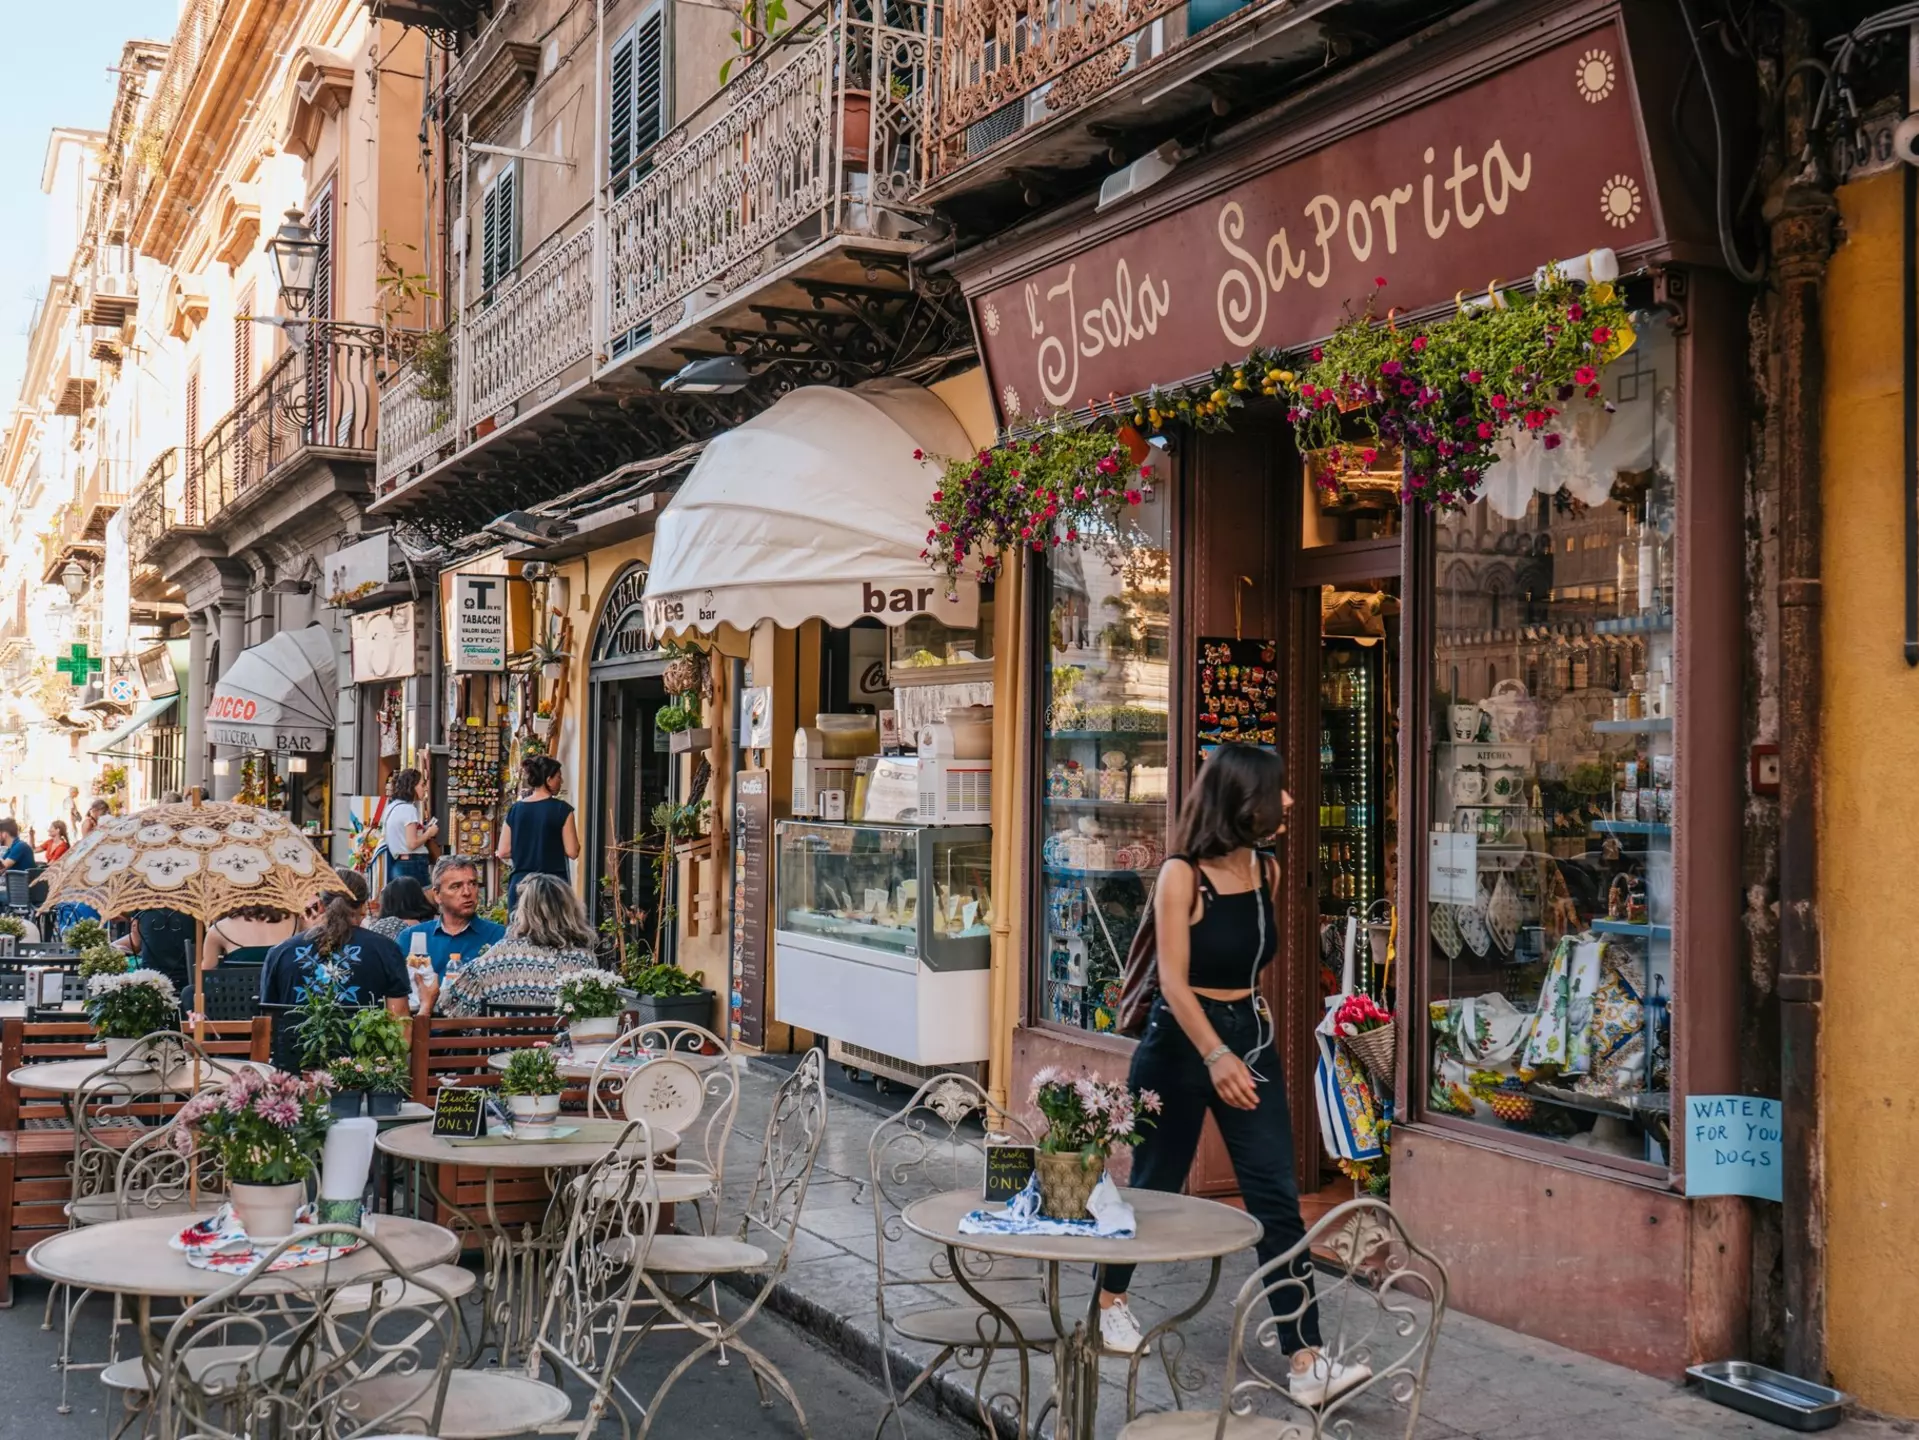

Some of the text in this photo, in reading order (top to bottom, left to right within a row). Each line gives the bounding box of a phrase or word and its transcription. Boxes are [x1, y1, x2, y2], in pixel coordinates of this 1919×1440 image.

[468, 580, 496, 610] T
[863, 582, 934, 613] bar
[601, 570, 649, 638] TABAC
[462, 614, 501, 625] TABACCHI
[698, 609, 716, 620] bar
[462, 645, 500, 654] Totocalcio
[276, 735, 311, 750] BAR
[1477, 751, 1512, 760] KITCHEN
[1693, 1098, 1774, 1119] WATER
[437, 1117, 473, 1131] ONLY
[1696, 1125, 1728, 1142] FOR
[1715, 1148, 1771, 1167] DOGS
